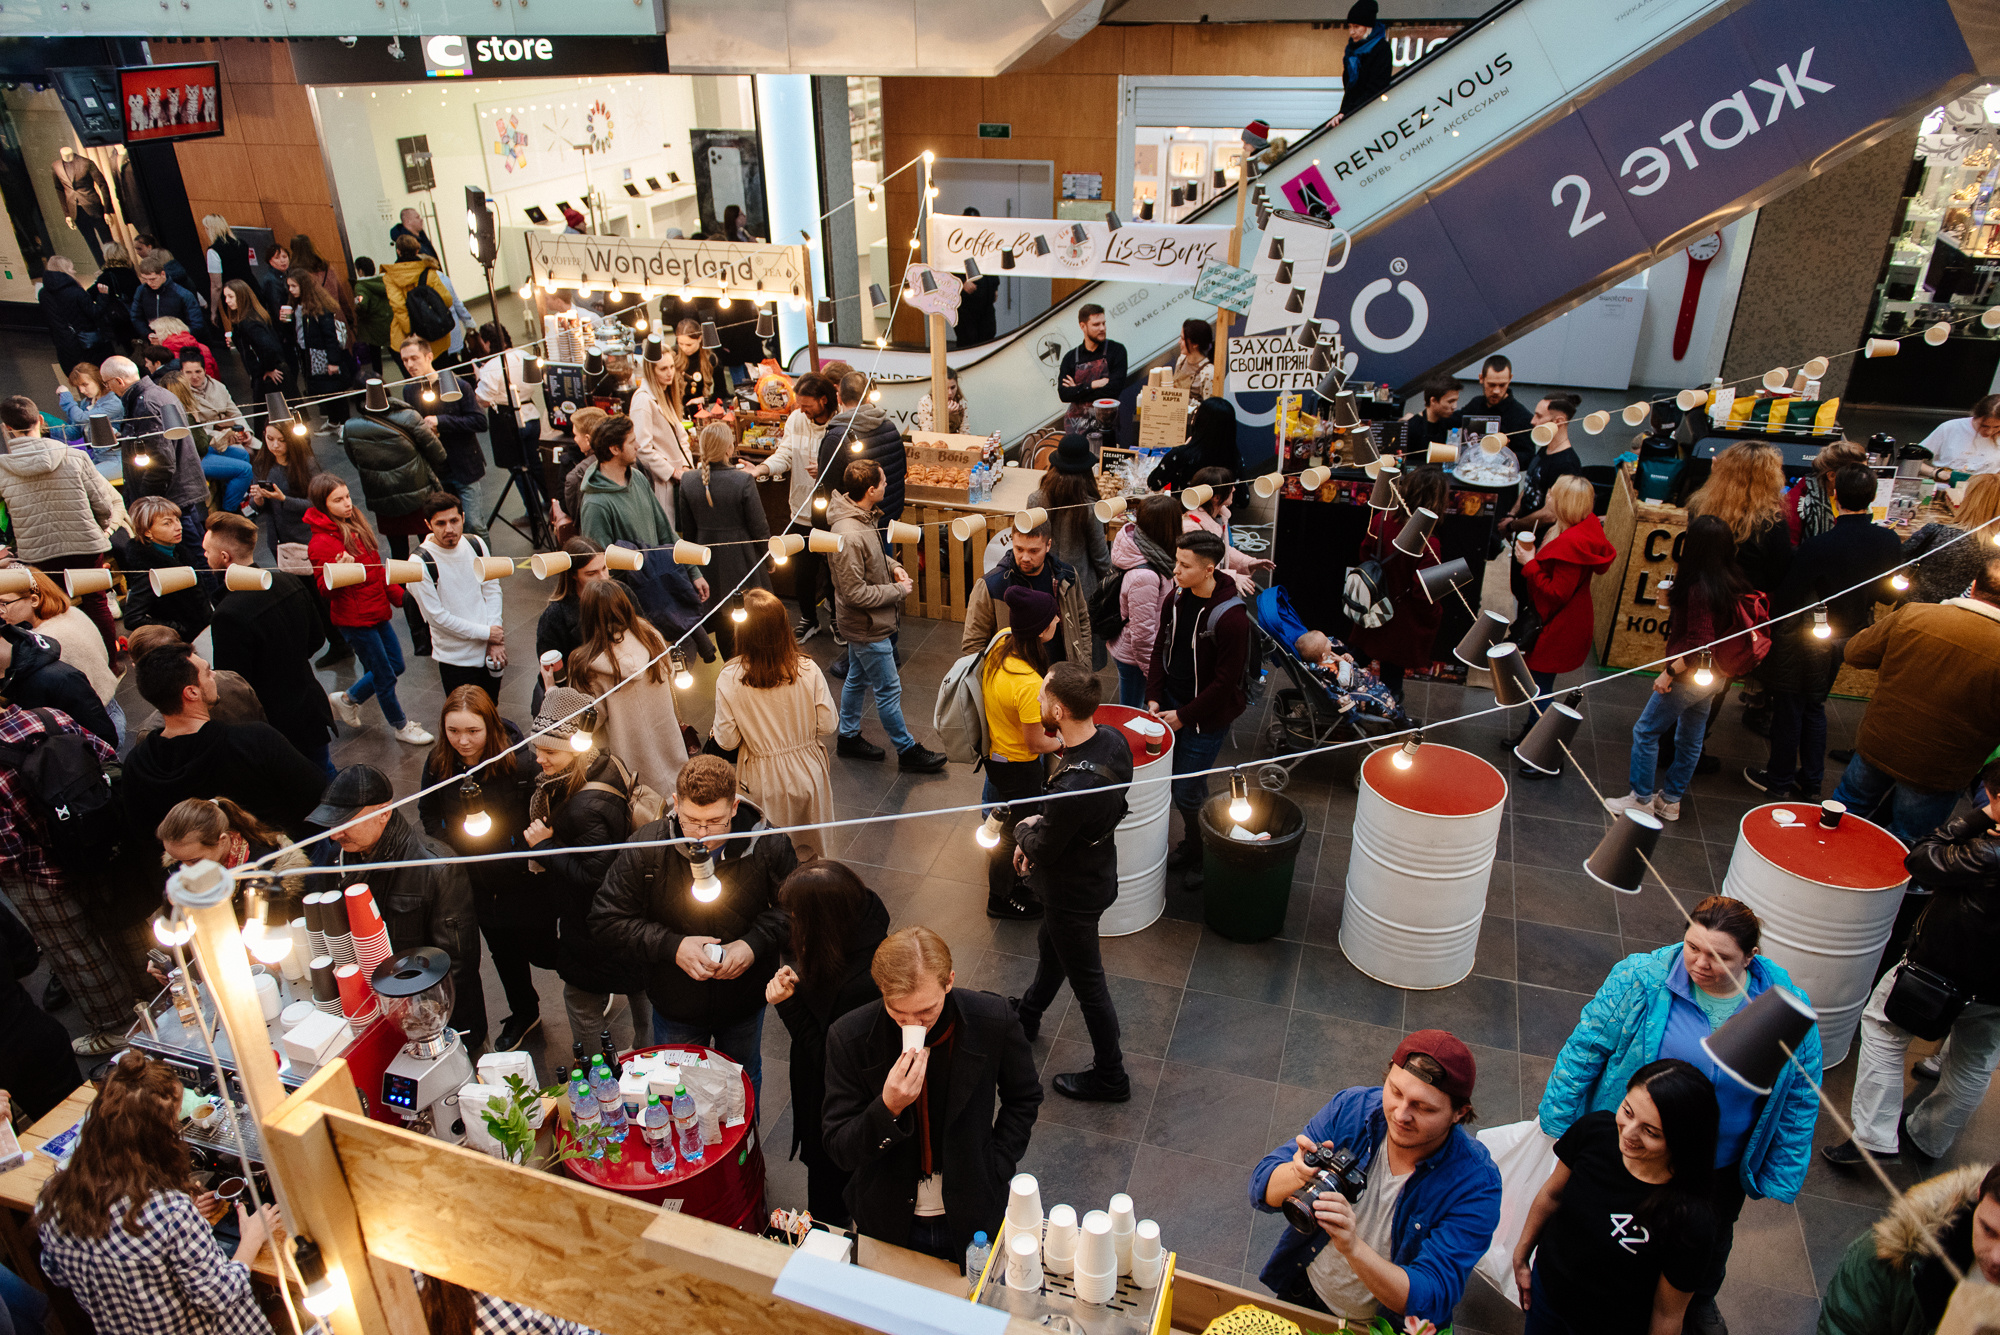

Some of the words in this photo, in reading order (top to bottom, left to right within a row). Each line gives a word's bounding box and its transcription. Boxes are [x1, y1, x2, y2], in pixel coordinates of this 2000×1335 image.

[476, 36, 553, 62] store
[1334, 52, 1513, 181] RENDEZ-VOUS
[1360, 165, 1392, 188] ОБУВЬ
[1400, 136, 1434, 162] СУМКИ
[1443, 86, 1510, 134] АКСЕССУАРЫ
[1551, 174, 1607, 238] 2
[947, 228, 1004, 253] Coffee
[1012, 231, 1038, 259] Ba
[1153, 237, 1218, 269] Boris
[551, 255, 582, 266] COFFEE
[587, 247, 753, 286] Wonderland
[763, 267, 781, 278] TEA
[1109, 288, 1149, 319] KENZO
[1134, 309, 1159, 328] MARC
[938, 450, 970, 464] Boris
